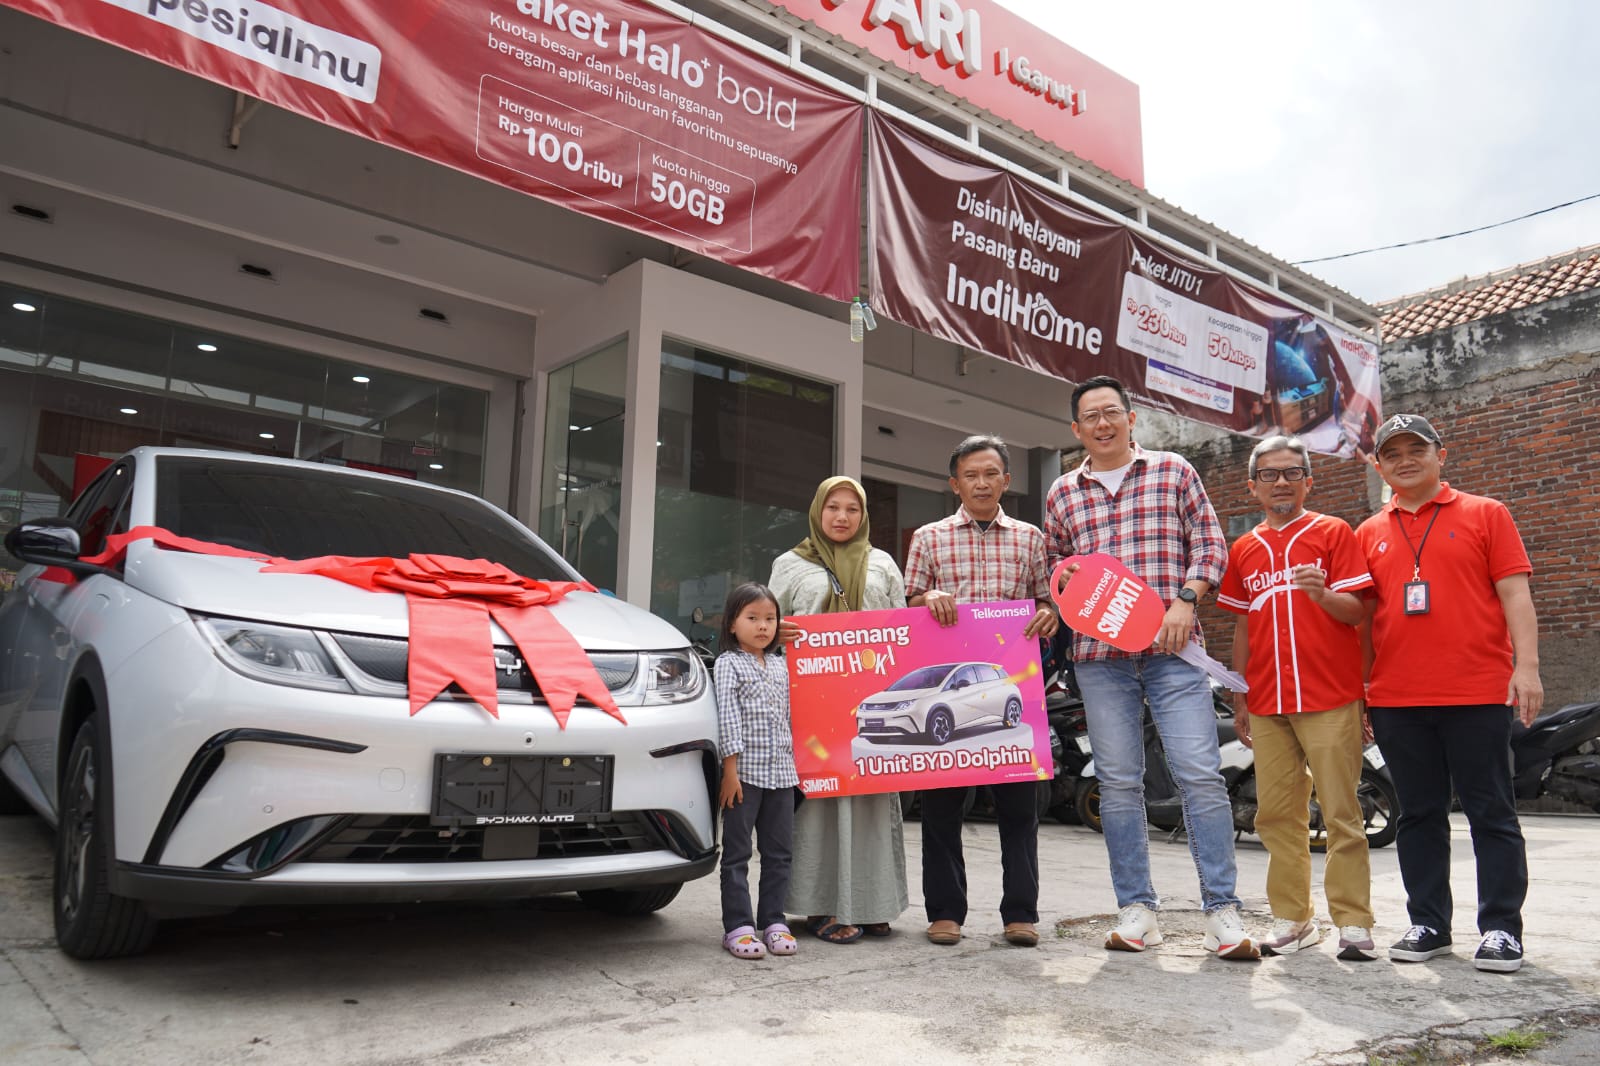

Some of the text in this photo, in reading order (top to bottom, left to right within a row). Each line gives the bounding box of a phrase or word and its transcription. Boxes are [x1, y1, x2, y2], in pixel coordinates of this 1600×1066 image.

[490, 11, 723, 125] Kuota besar dan bebas langganan
[1010, 56, 1075, 107] Garut
[488, 33, 798, 175] beragam aplikasi hiburan favoritmu sepuasnya
[498, 95, 583, 138] Harga Mulai
[717, 64, 797, 131] bold
[498, 114, 520, 135] Rp
[652, 153, 731, 194] Kuota hingga
[650, 172, 726, 225] 50GB
[957, 187, 1081, 259] Disini Melayani
[951, 220, 1060, 283] Pasang Baru
[1131, 248, 1169, 281] Paket
[1167, 267, 1196, 293] JITU
[946, 262, 1102, 355] IndiHome
[971, 604, 1031, 620] Telkomsel
[1078, 567, 1113, 618] Telkomsel
[1097, 577, 1144, 639] SIMPATI
[794, 625, 911, 649] Pemenang
[796, 655, 844, 675] SIMPATI
[802, 777, 839, 793] SIMPATI
[855, 745, 1032, 777] 1 Unit BYD Dolphin
[538, 815, 575, 823] AUTO
